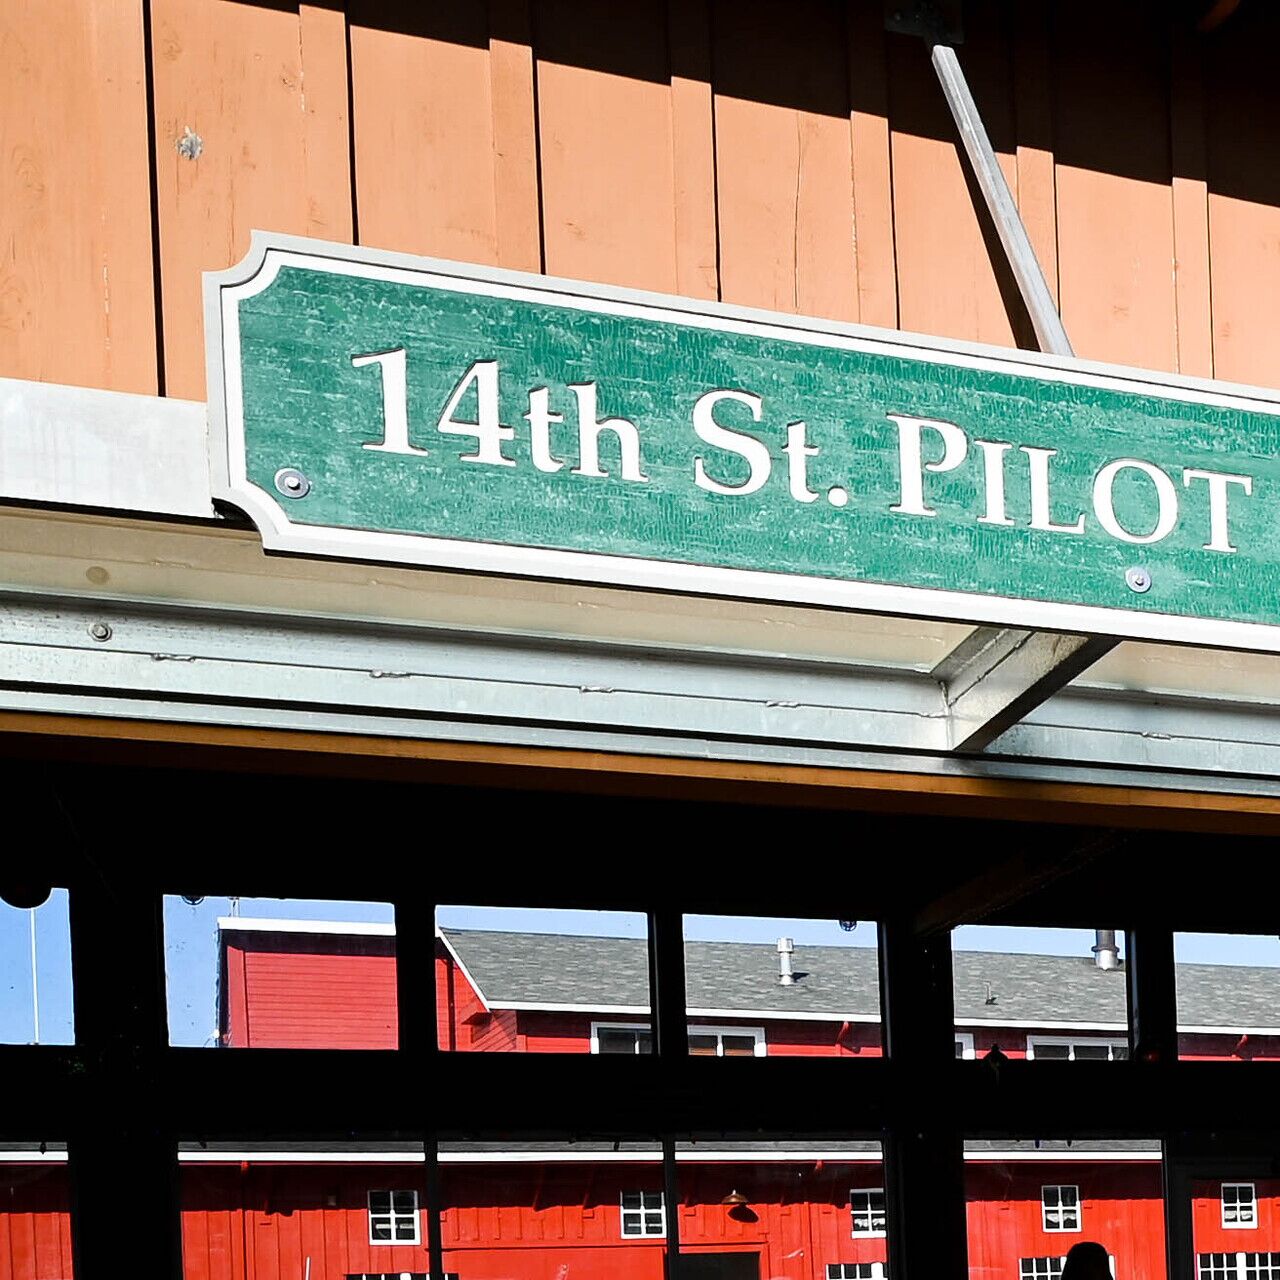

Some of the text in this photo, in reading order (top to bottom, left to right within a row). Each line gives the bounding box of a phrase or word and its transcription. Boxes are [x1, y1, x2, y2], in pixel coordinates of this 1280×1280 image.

[351, 347, 649, 484] 14th
[692, 390, 849, 508] St.
[887, 414, 1253, 555] PILOT
